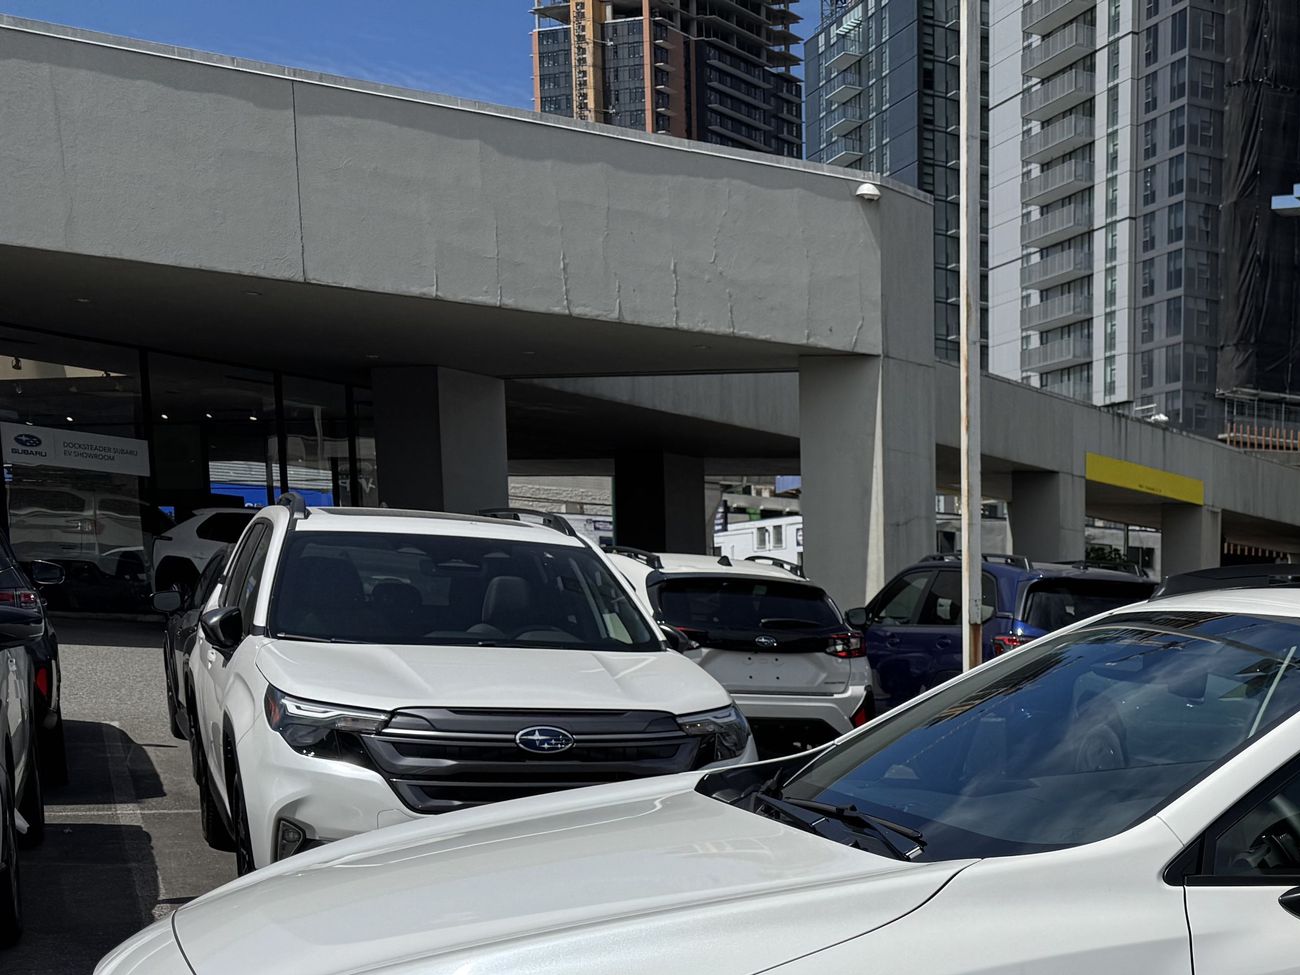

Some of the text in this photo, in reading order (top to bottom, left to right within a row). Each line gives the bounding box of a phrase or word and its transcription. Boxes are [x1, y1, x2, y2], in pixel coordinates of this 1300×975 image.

[11, 448, 47, 457] SUBARU
[63, 441, 138, 457] DOCKSTEADER SUBARU
[73, 451, 115, 461] SHOWROOM
